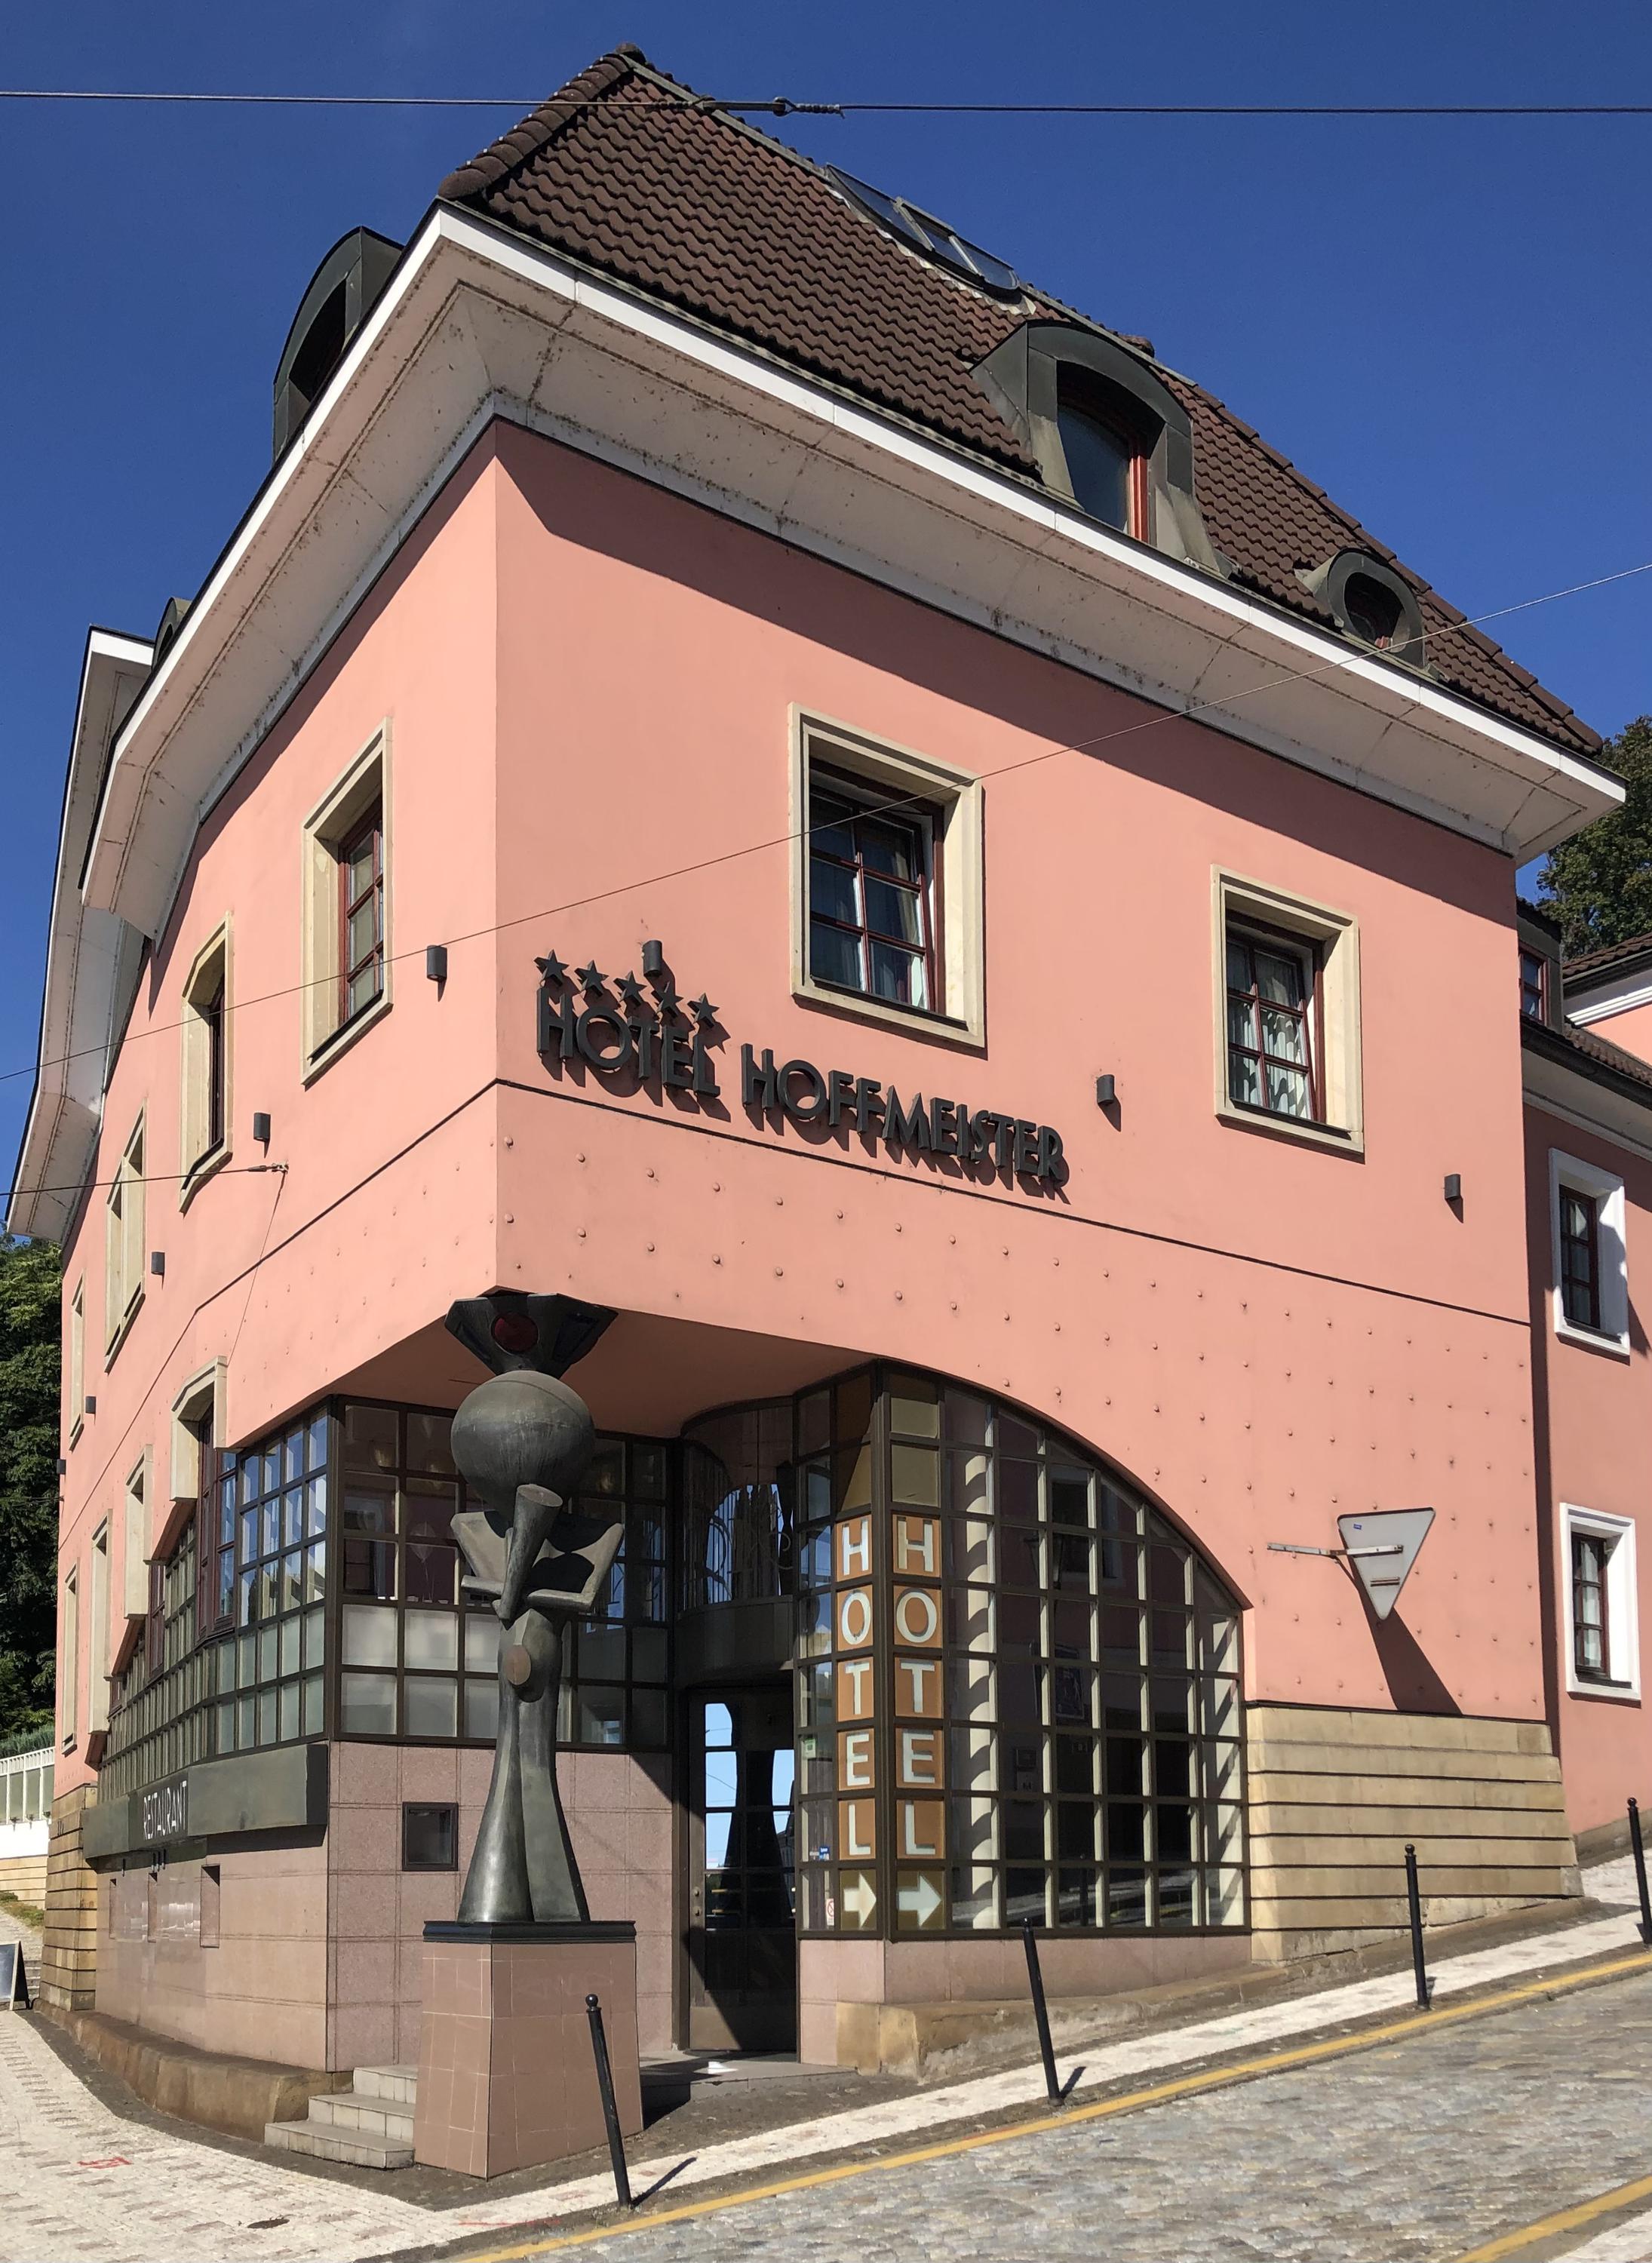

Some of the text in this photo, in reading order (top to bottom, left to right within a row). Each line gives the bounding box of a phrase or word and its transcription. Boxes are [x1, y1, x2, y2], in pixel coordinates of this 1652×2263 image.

[536, 987, 1064, 1182] HOTEL HOFFMEISTER
[143, 1780, 187, 1840] RESTAURANT
[841, 1518, 872, 1856] HOTEL
[896, 1518, 938, 1856] HOTEL
